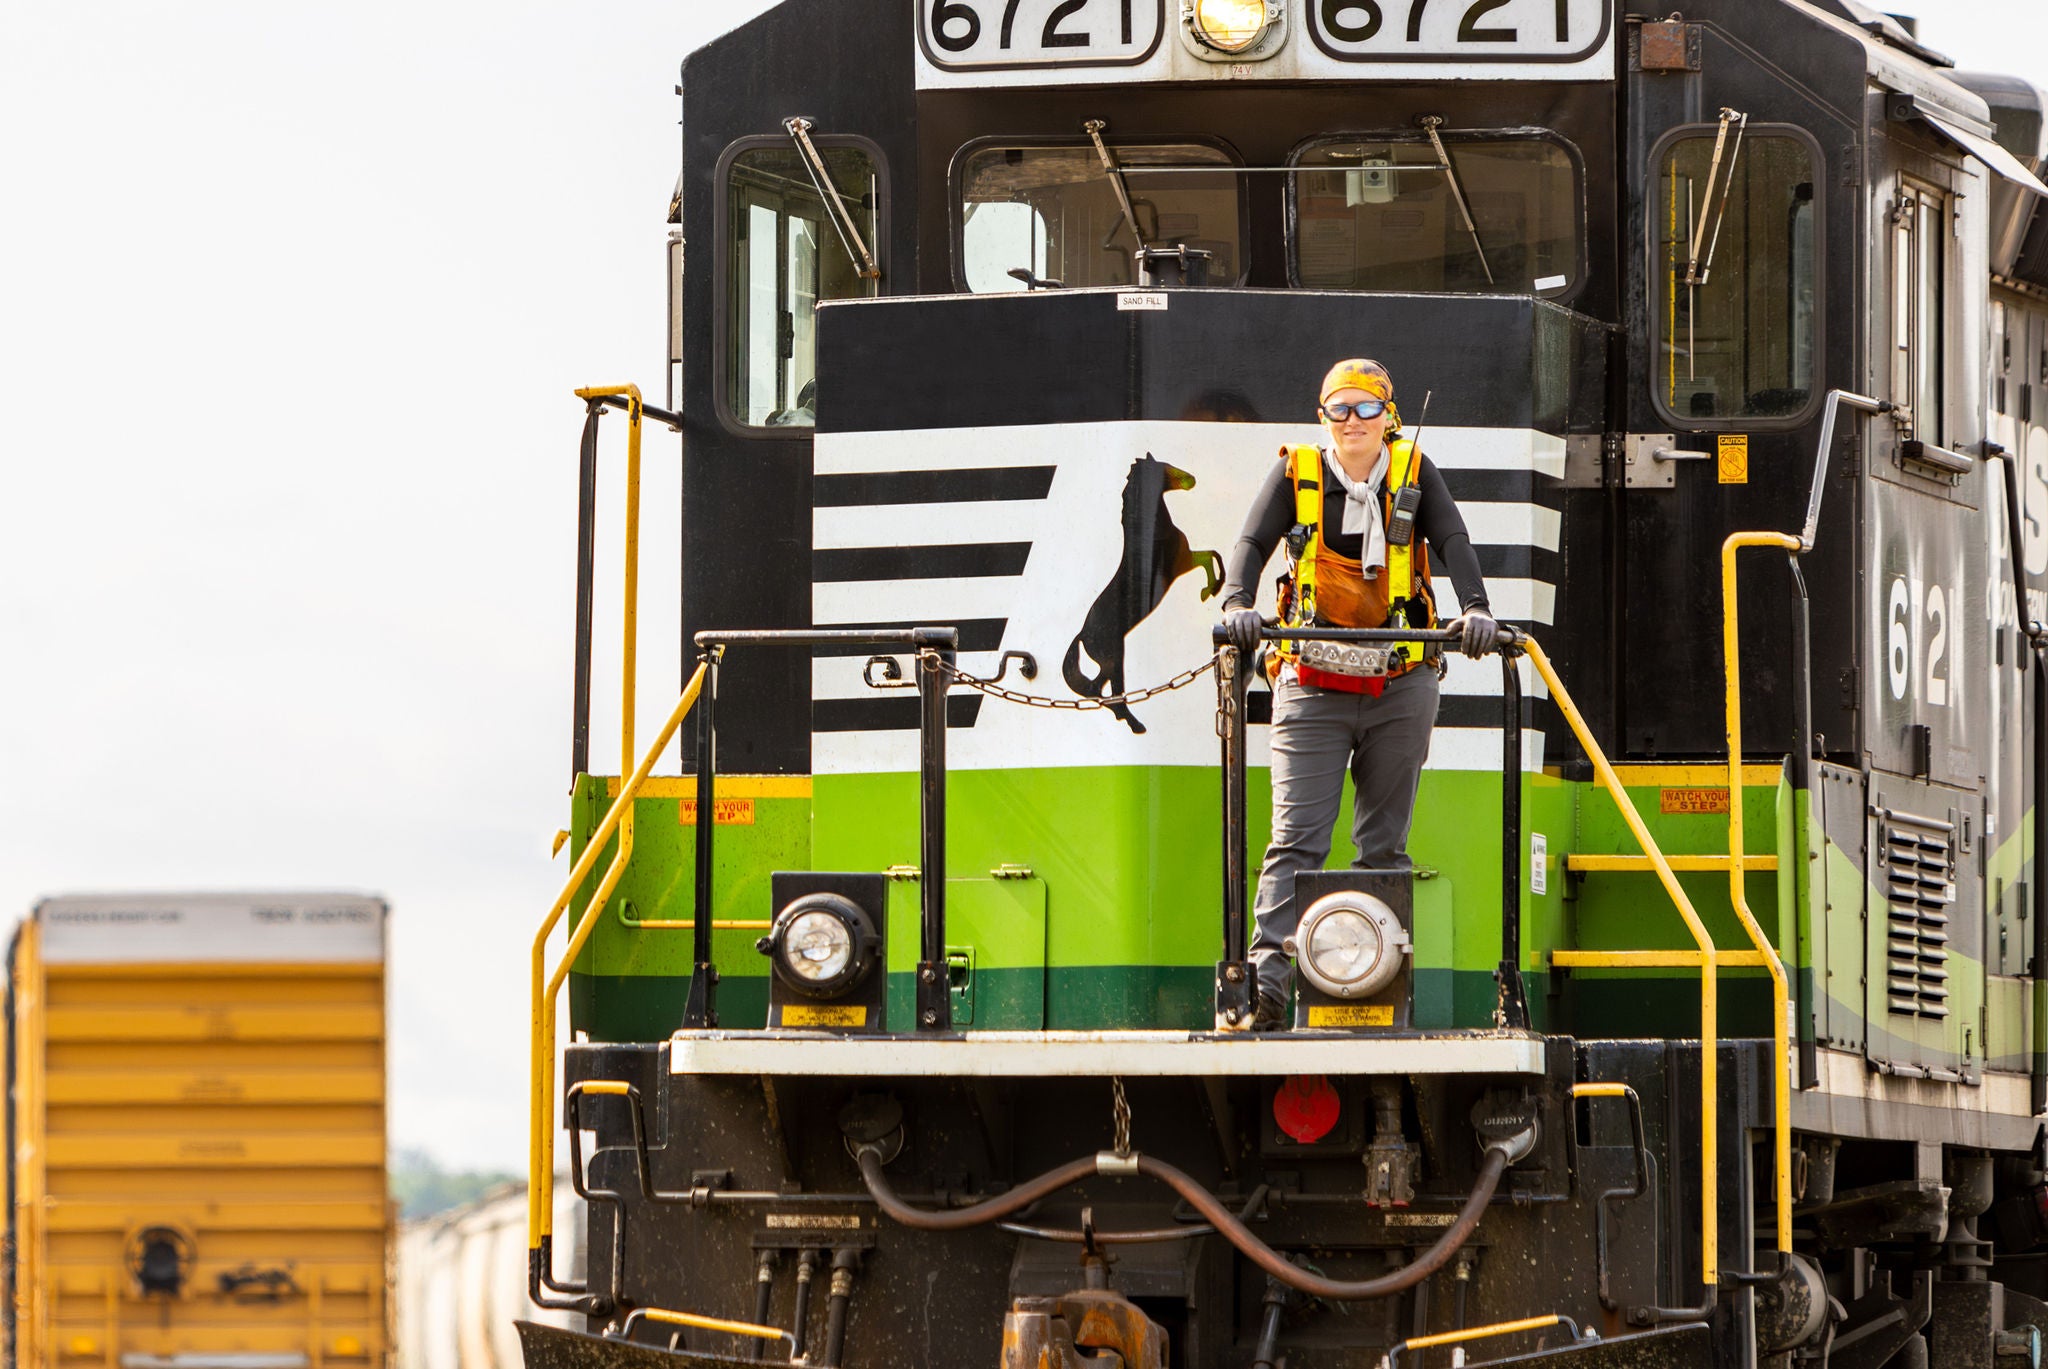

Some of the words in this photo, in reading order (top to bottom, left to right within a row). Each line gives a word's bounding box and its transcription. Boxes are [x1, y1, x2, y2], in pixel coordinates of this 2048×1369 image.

[1123, 297, 1143, 305] SAND
[1146, 297, 1162, 305] FILL
[1665, 792, 1701, 800] WATCH
[684, 803, 720, 811] WAH
[723, 803, 749, 811] YOUR
[1680, 801, 1717, 810] STEP
